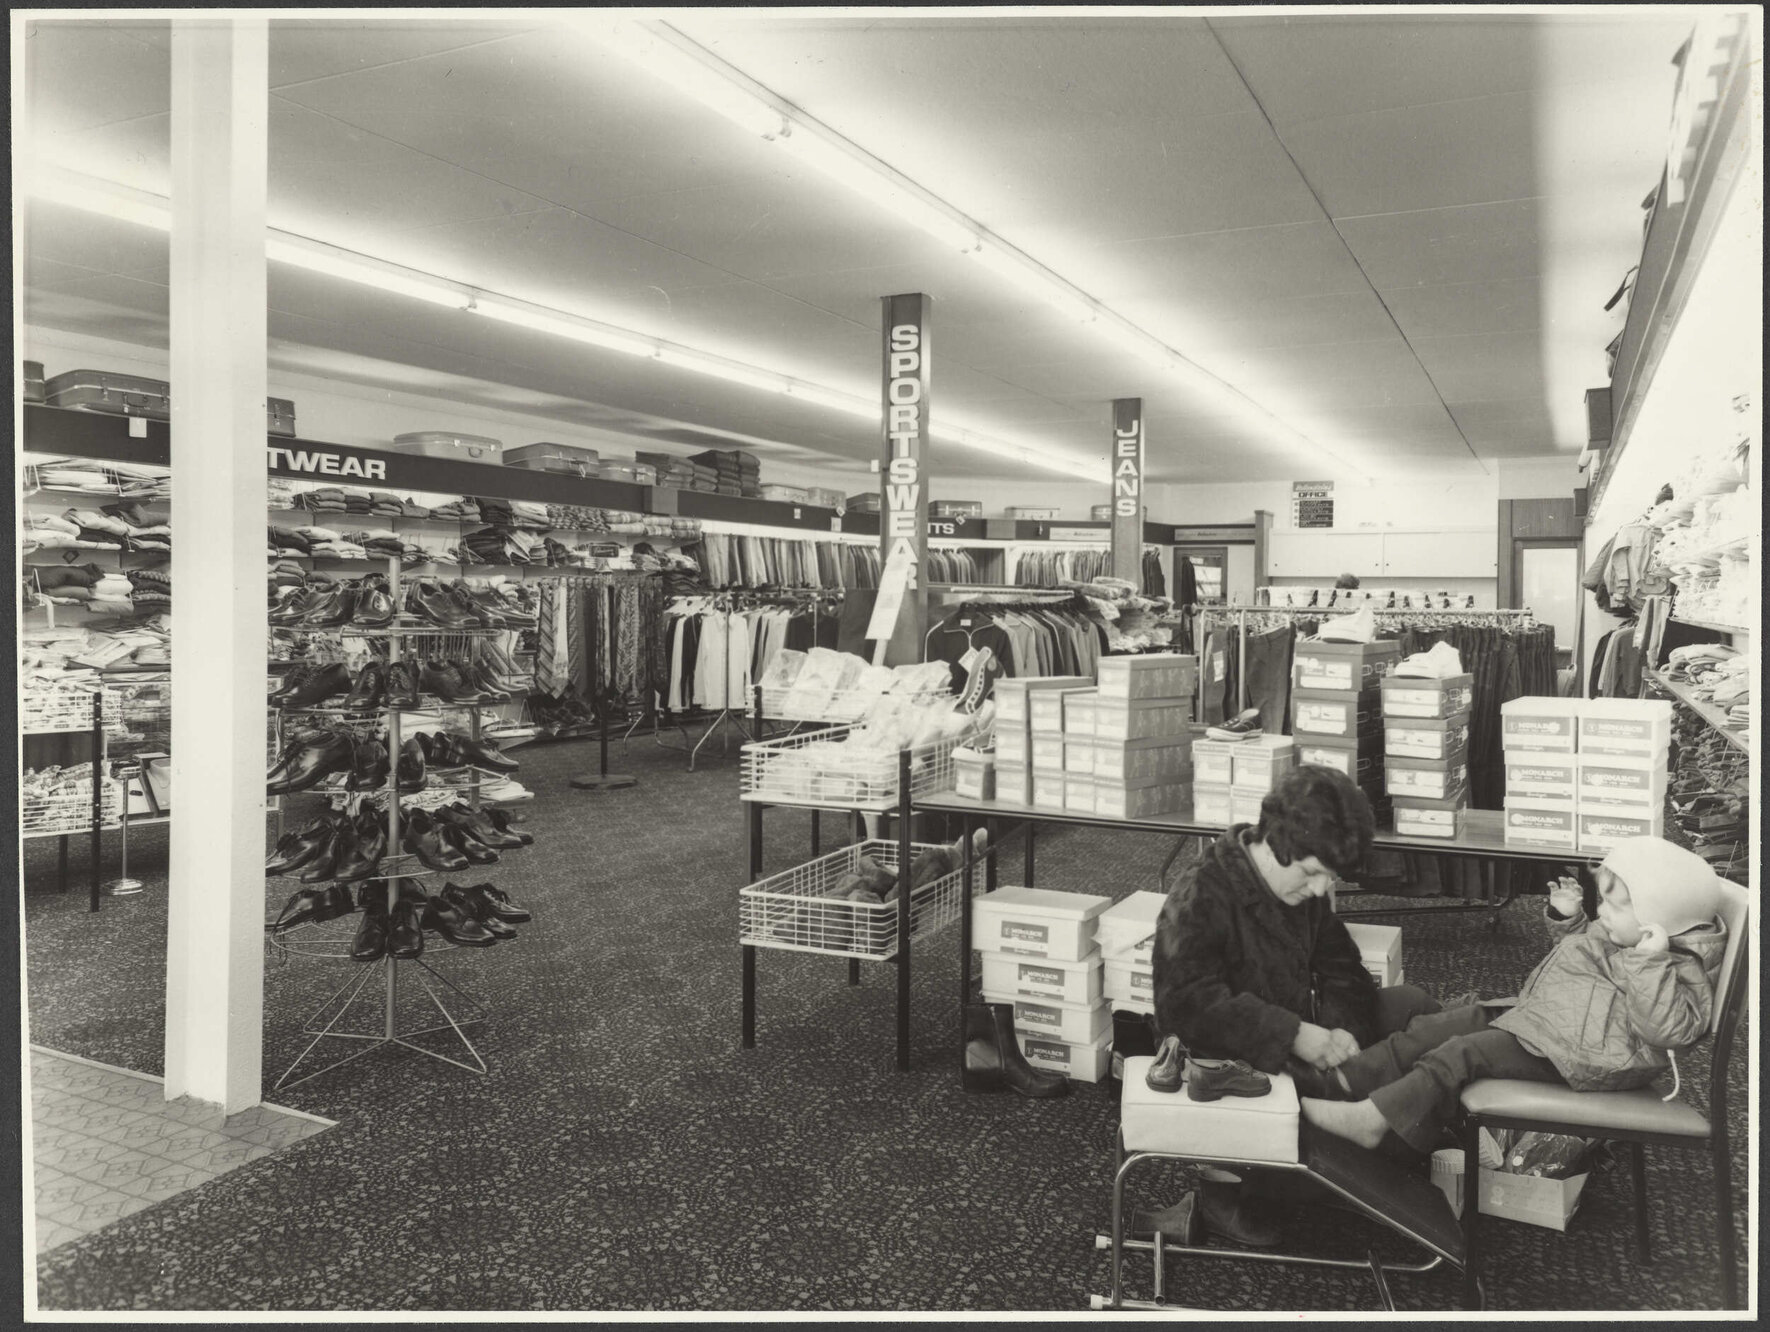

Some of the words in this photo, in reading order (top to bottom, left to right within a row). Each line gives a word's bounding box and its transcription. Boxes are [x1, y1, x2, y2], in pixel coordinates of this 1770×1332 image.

[267, 447, 386, 480] TWEAR
[1115, 420, 1139, 517] JEANS
[1521, 769, 1564, 778] MONARCH
[1011, 928, 1043, 938] MONARCH
[1027, 971, 1058, 980] MONARCH
[1024, 1010, 1056, 1020] MONARCH
[1033, 1047, 1064, 1057] MONARCH
